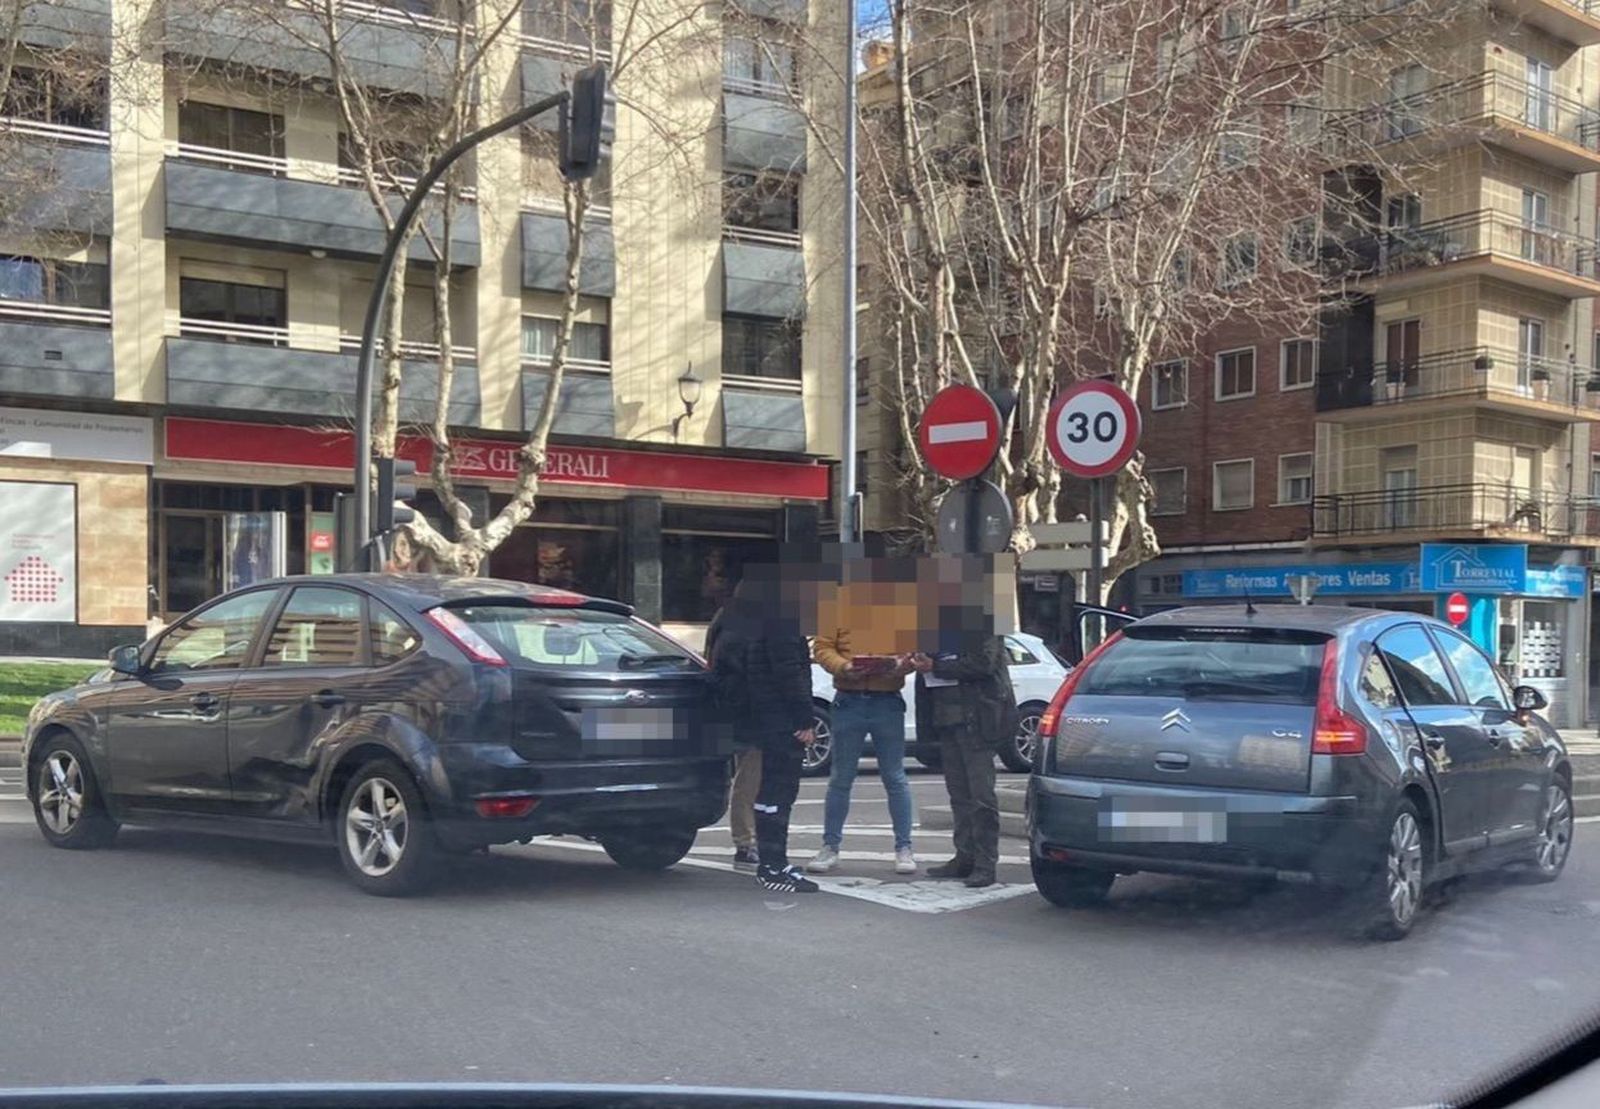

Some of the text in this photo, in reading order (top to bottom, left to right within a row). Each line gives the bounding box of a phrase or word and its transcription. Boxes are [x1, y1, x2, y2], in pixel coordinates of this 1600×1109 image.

[1067, 411, 1118, 443] 30
[488, 449, 609, 478] GEERALI
[1225, 573, 1278, 588] Reformas
[1347, 569, 1392, 586] Ventas
[1271, 729, 1302, 738] C4
